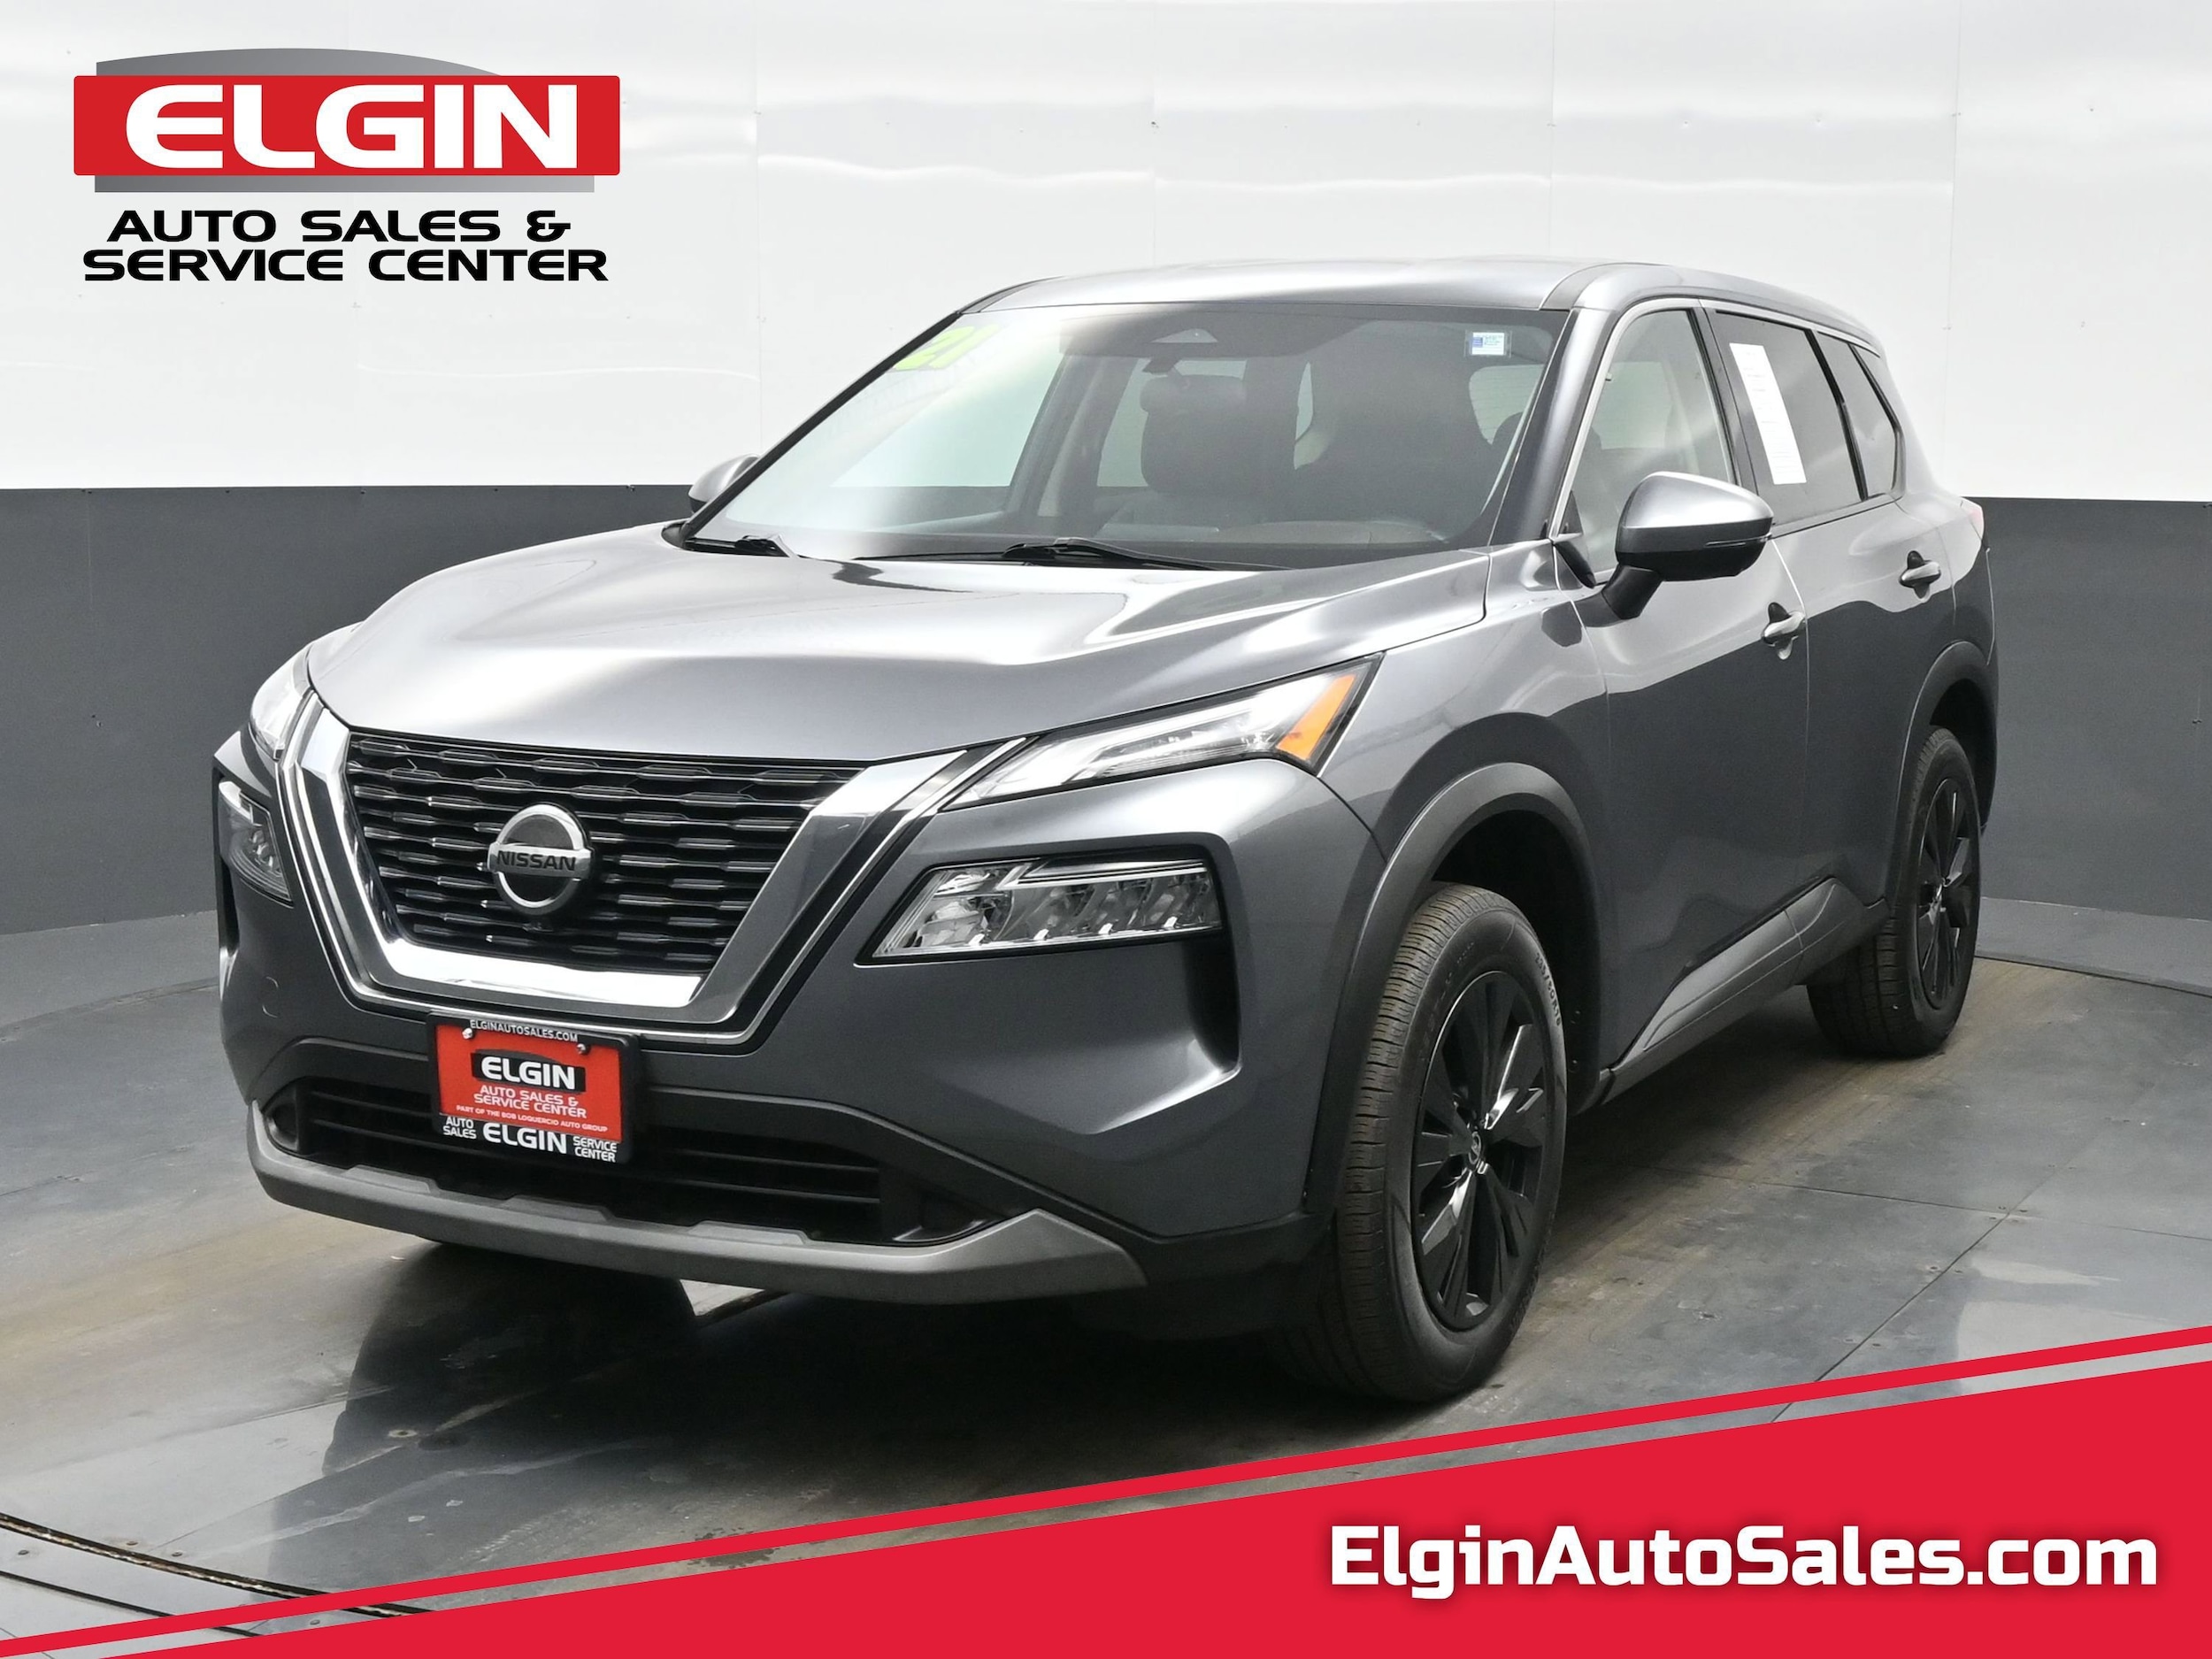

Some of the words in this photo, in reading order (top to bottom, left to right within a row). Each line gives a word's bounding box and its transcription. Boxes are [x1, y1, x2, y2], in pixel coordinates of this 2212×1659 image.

[496, 850, 575, 871] NISSAN
[470, 1019, 578, 1042] ELGINAUTOSALES.COM
[481, 1056, 575, 1089] ELGIN
[473, 1094, 530, 1110] SERVICE
[534, 1103, 587, 1118] CENTER
[480, 1085, 516, 1098] AUTO
[519, 1090, 564, 1105] SALES
[568, 1096, 579, 1106] &
[442, 1125, 477, 1140] SALES
[445, 1116, 474, 1129] AUTO
[560, 1120, 580, 1129] AUTO
[581, 1123, 608, 1133] GROUP
[483, 1122, 566, 1154] ELGIN
[572, 1136, 617, 1153] SERVICE
[574, 1147, 616, 1163] CENTER
